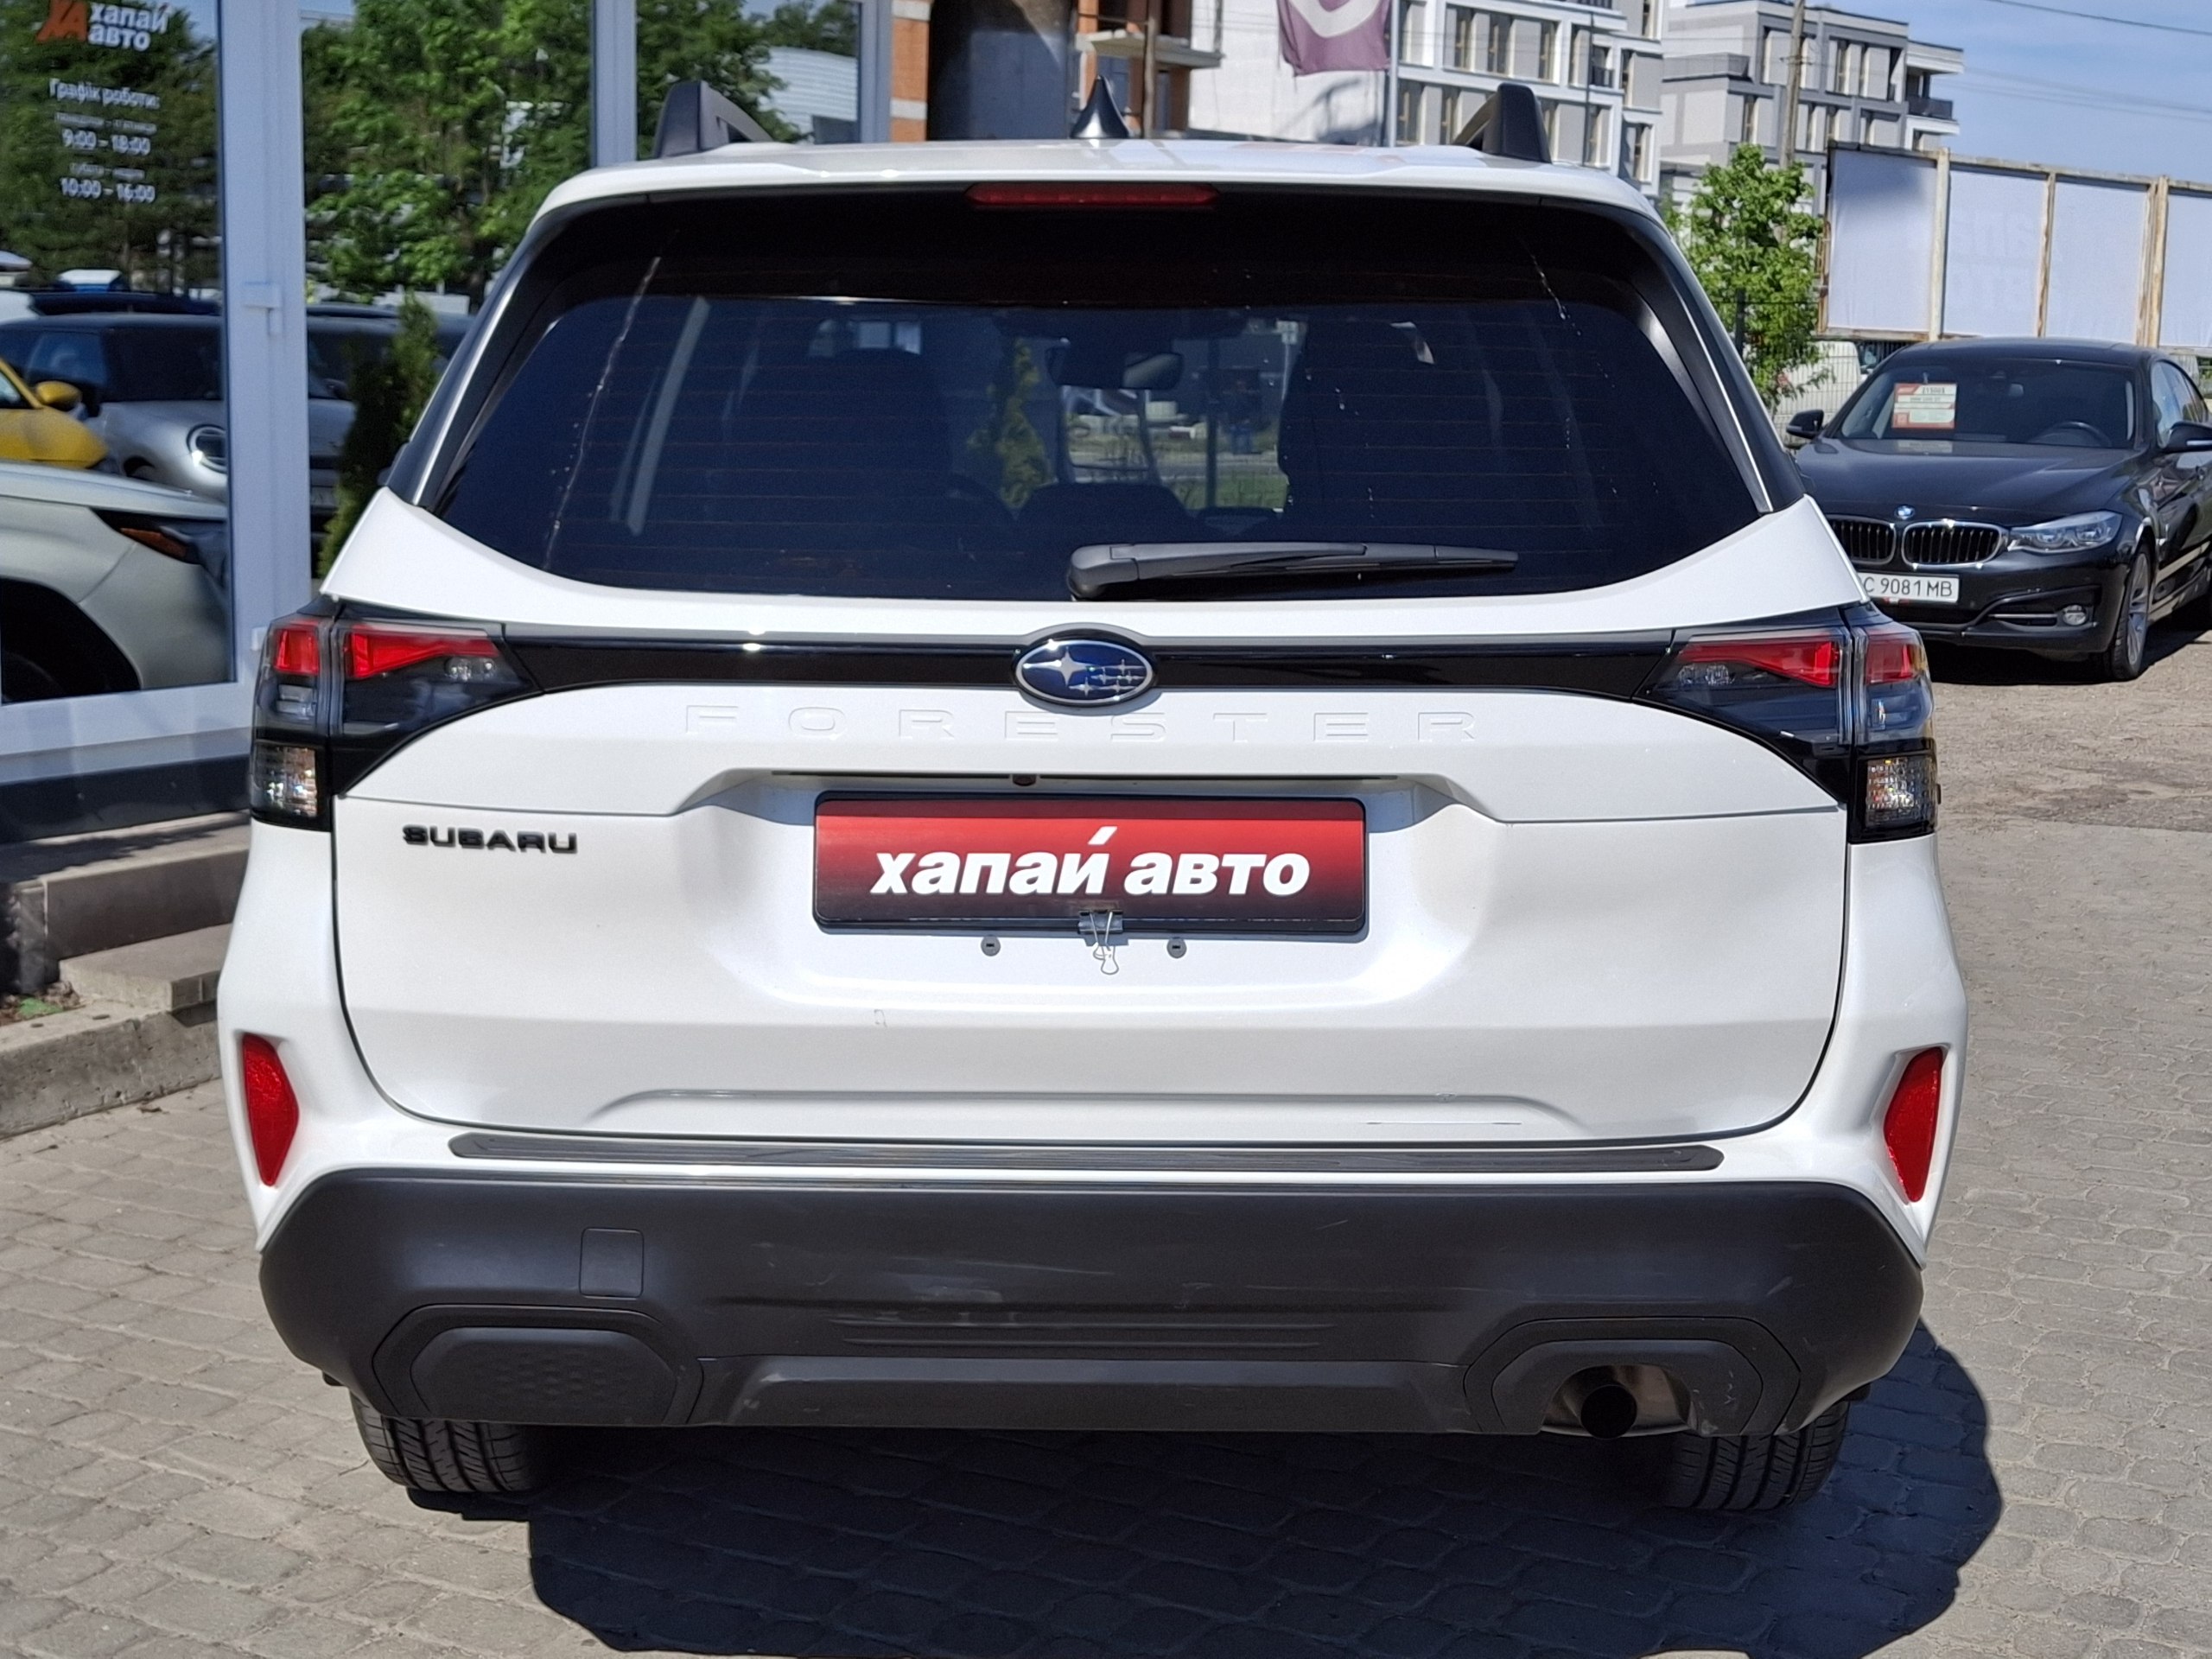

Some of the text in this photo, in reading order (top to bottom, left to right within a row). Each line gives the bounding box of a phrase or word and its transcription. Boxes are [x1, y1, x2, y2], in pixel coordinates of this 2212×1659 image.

[89, 2, 169, 34] хапай
[88, 23, 150, 51] авто
[1880, 577, 1921, 596] 9081
[1926, 580, 1953, 597] MB
[685, 704, 1475, 742] FORESTER
[402, 824, 577, 854] SUBARU
[1122, 851, 1310, 896] авто
